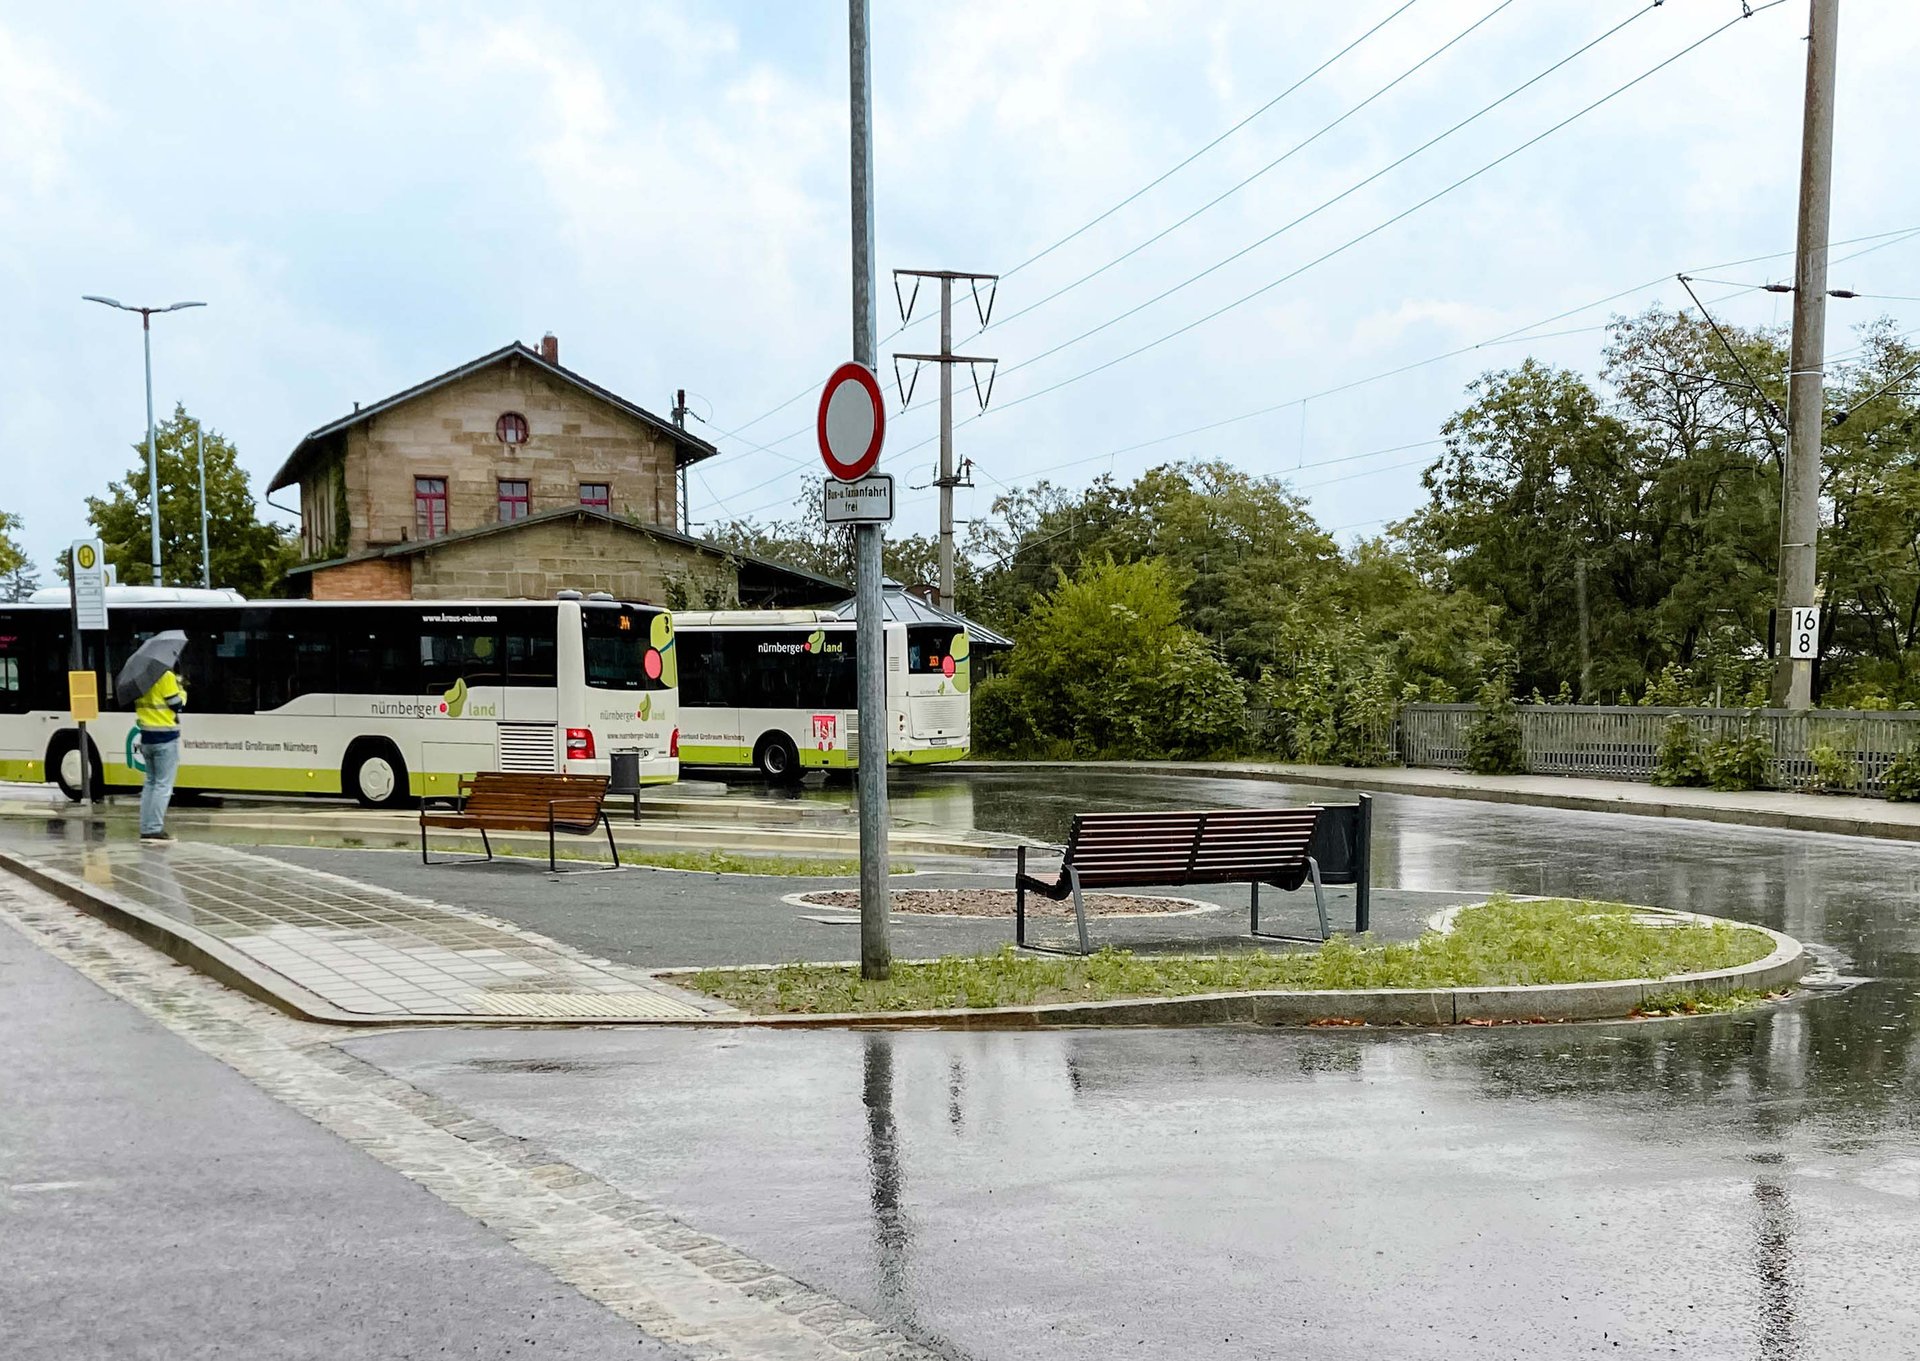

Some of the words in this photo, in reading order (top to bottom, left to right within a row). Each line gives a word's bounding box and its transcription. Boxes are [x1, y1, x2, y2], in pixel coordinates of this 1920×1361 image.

[845, 500, 858, 512] frei
[82, 550, 91, 565] H
[422, 612, 498, 623] www.kraus-reisen.com
[1795, 610, 1816, 631] 16
[757, 641, 804, 655] nürnberger
[823, 641, 843, 653] land
[1799, 633, 1810, 653] 8
[371, 701, 437, 719] nürnberger
[468, 702, 496, 717] land
[599, 710, 636, 722] nürnberger
[651, 710, 665, 720] land
[183, 739, 243, 750] Verkehrsverbund
[245, 740, 281, 752] Großraum
[283, 741, 318, 755] Nürnberg
